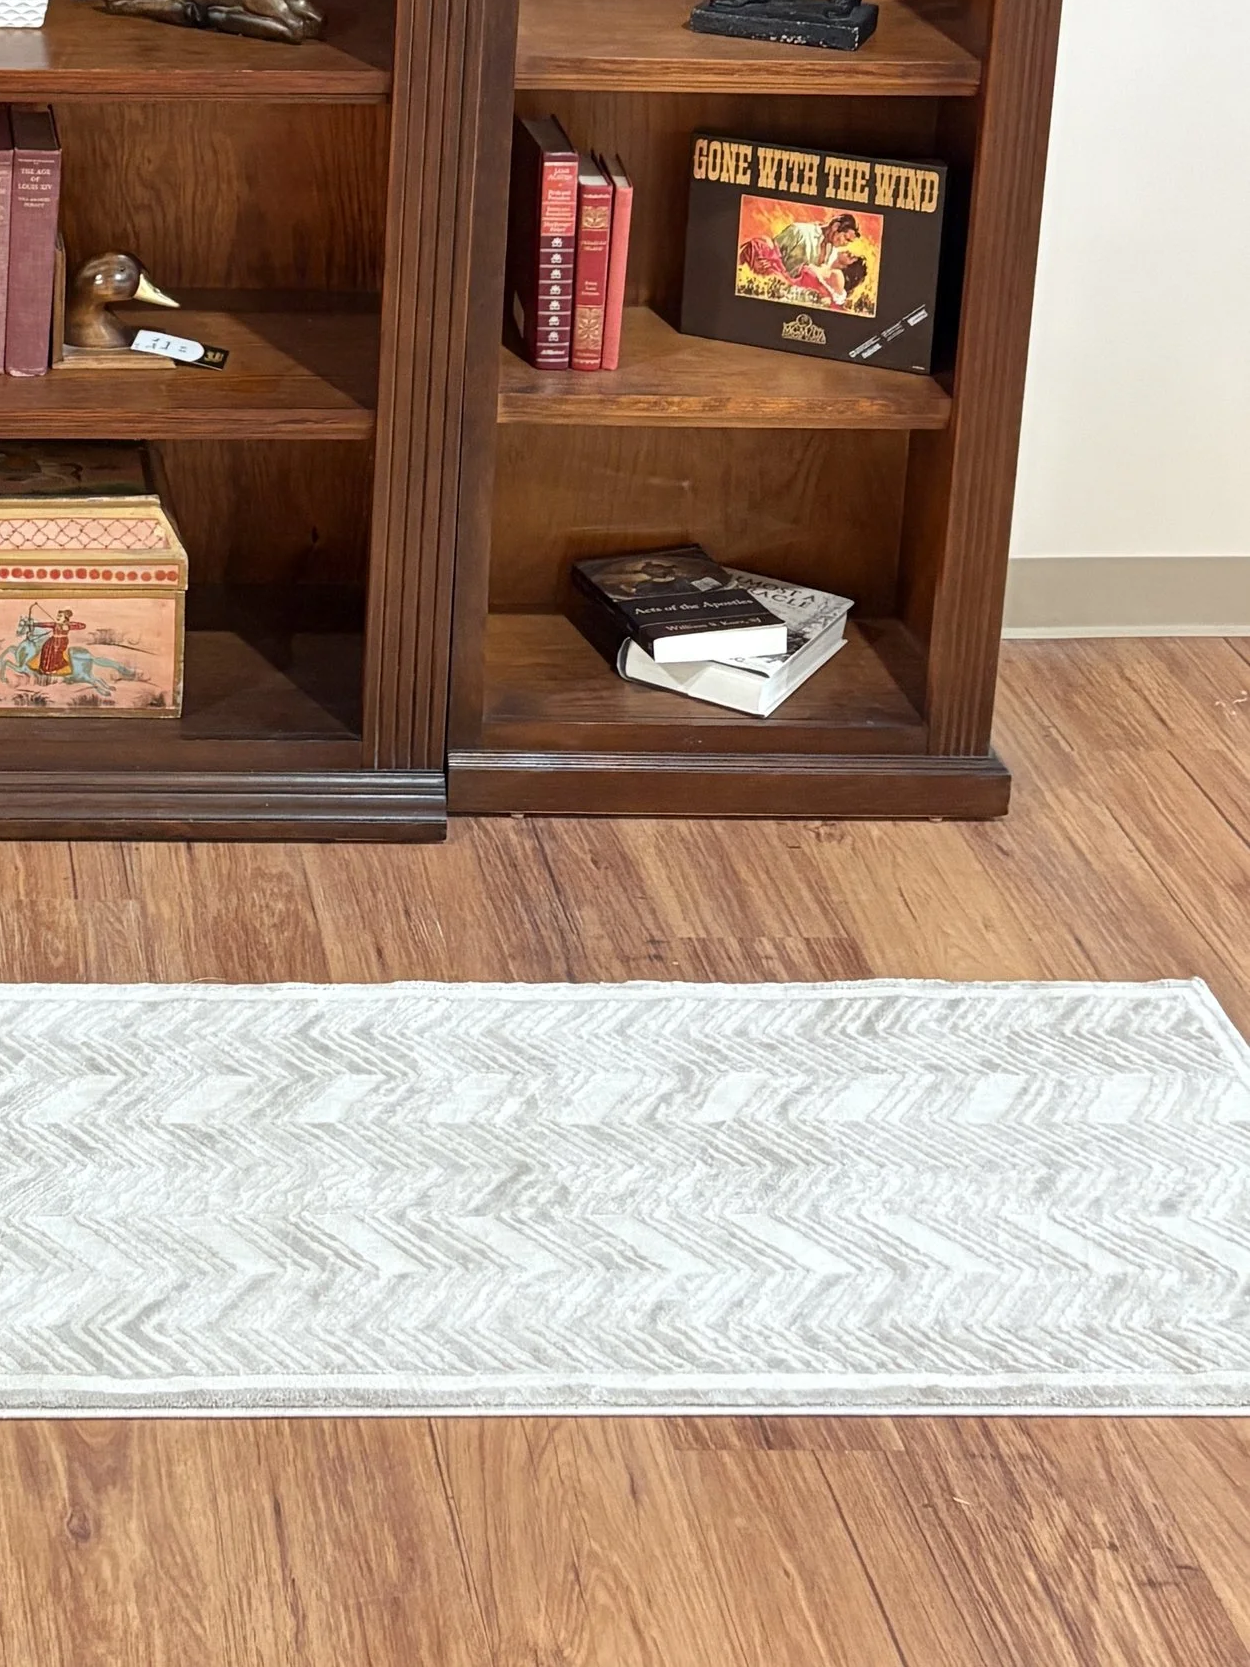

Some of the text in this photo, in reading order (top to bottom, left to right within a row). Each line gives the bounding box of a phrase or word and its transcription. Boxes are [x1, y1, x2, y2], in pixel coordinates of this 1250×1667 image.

[693, 138, 940, 214] GONE WITH THE WIND
[635, 607, 663, 615] Acts
[703, 598, 754, 609] Apostles
